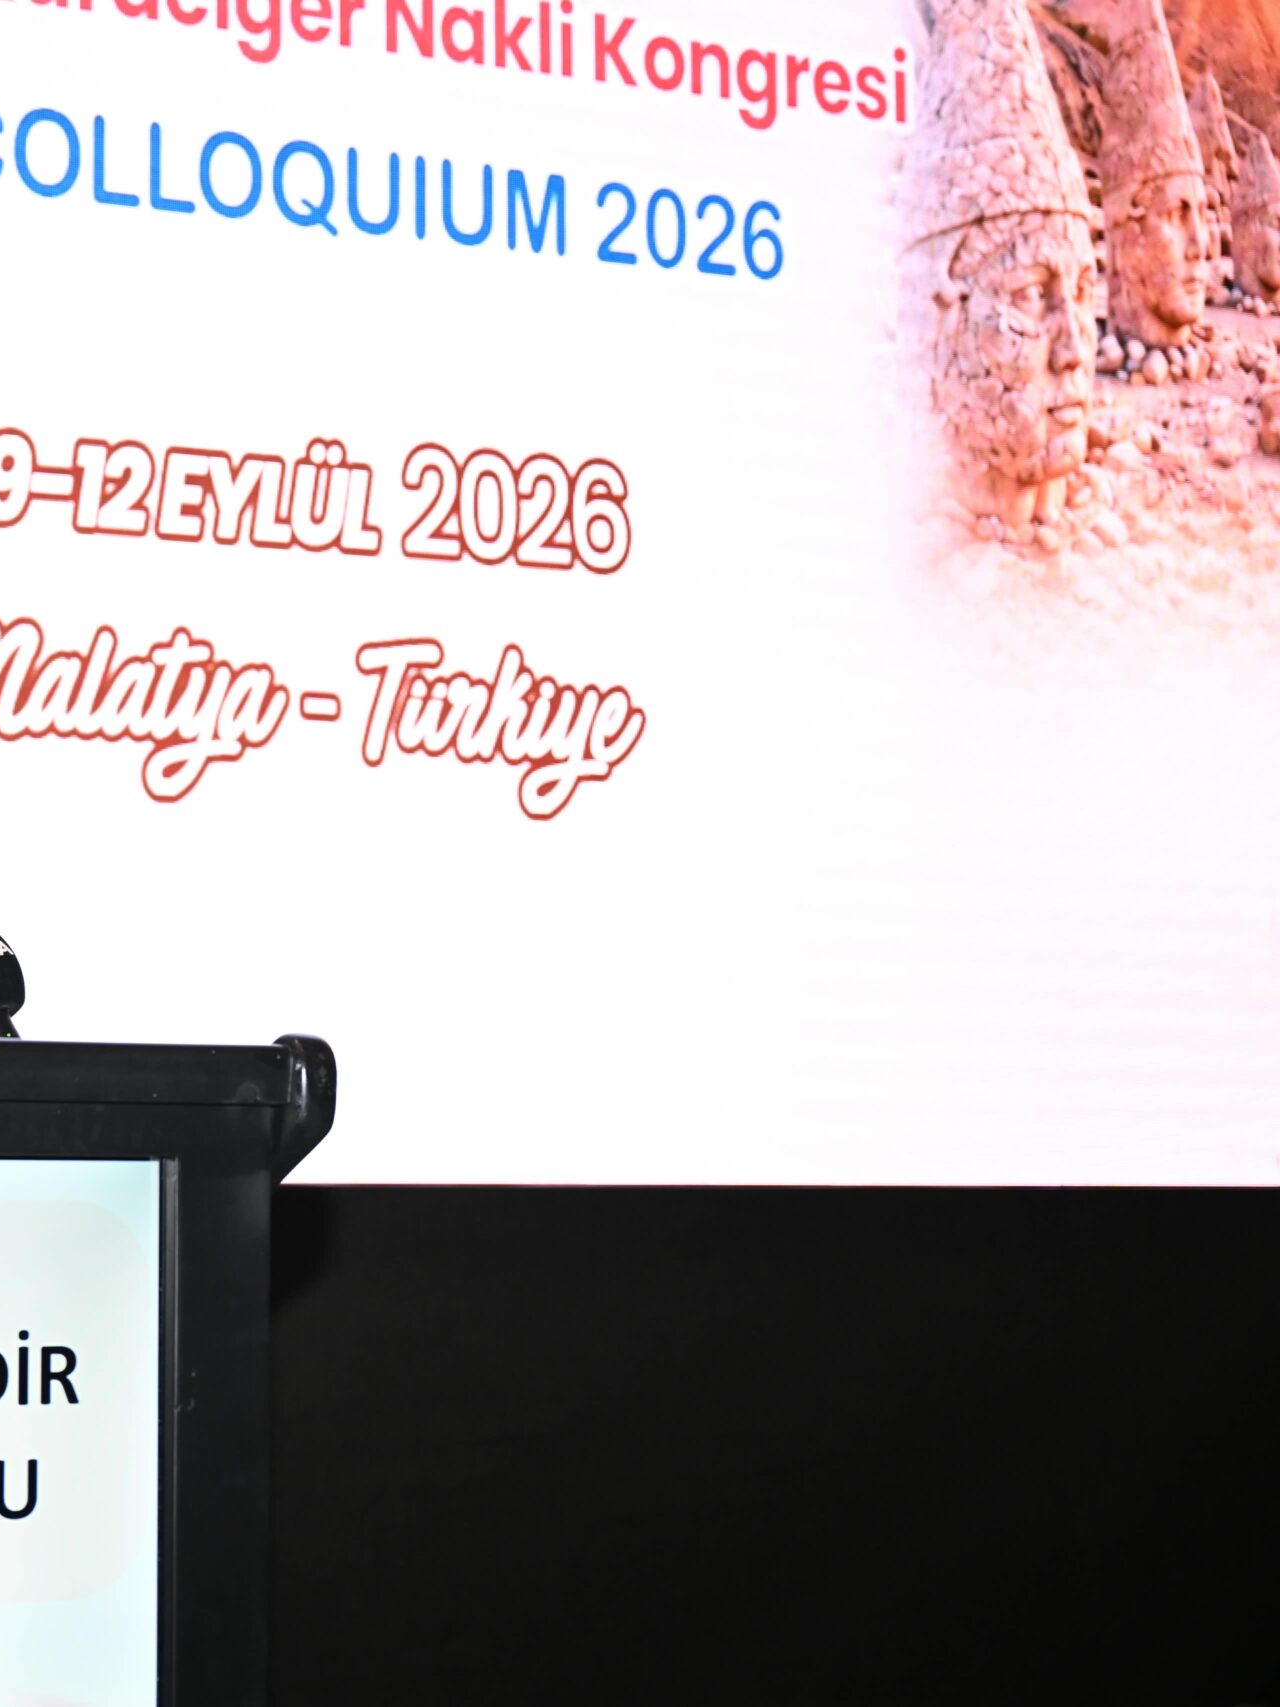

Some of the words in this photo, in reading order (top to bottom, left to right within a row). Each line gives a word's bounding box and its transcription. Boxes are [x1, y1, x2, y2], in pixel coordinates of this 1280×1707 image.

[385, 0, 574, 78] Nakli
[594, 13, 908, 131] Kongresi
[594, 181, 784, 281] 2026
[400, 441, 632, 576] 2026
[354, 636, 647, 822] Türkiye
